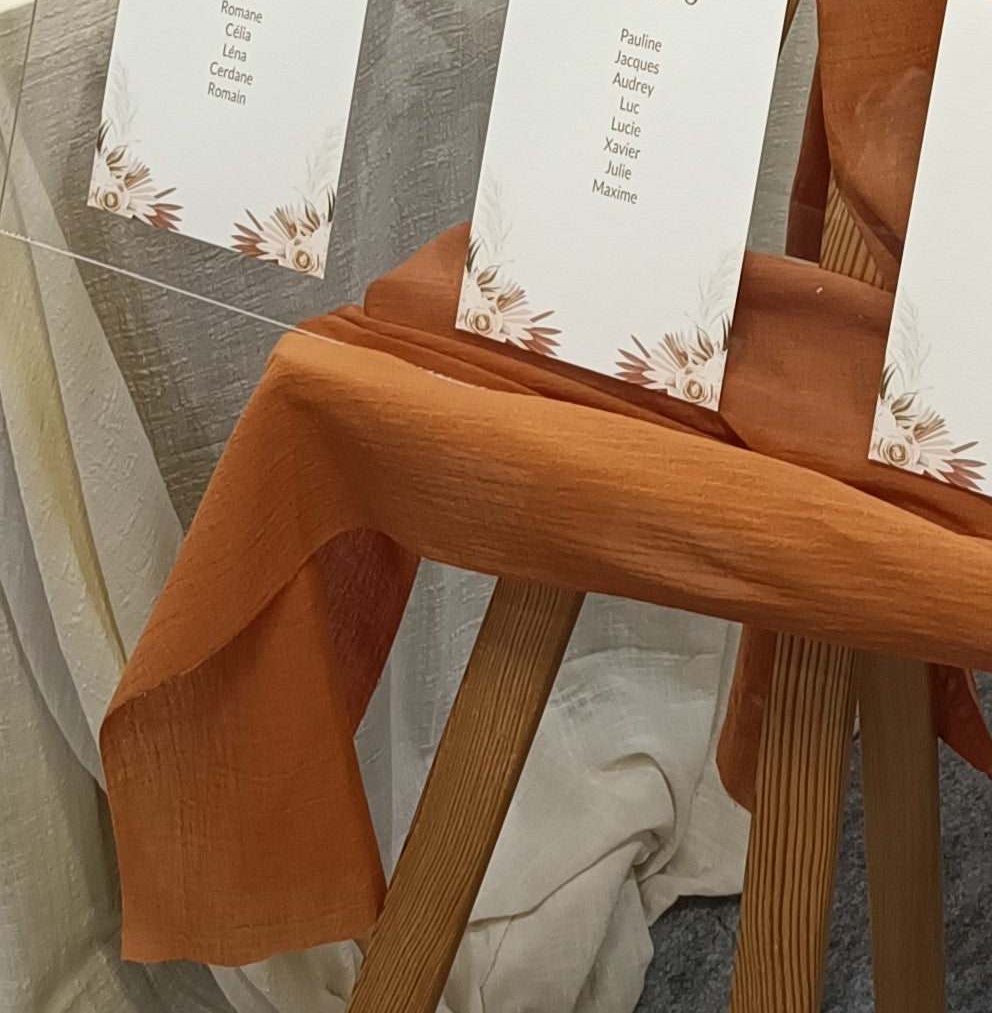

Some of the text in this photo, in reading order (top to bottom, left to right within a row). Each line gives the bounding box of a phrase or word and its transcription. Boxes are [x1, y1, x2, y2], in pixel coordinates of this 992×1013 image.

[221, 0, 262, 23] Romane
[225, 23, 251, 41] Célia
[621, 28, 662, 52] Pauline
[222, 44, 247, 62] Léna
[614, 50, 660, 75] Jacques
[210, 62, 253, 86] Cerdane
[613, 72, 654, 97] Audrey
[208, 82, 246, 105] Romain
[620, 97, 639, 114] Luc
[611, 117, 641, 137] Lucie
[604, 137, 640, 159] Xavier
[605, 160, 631, 180] Julie
[592, 179, 637, 204] Maxime
